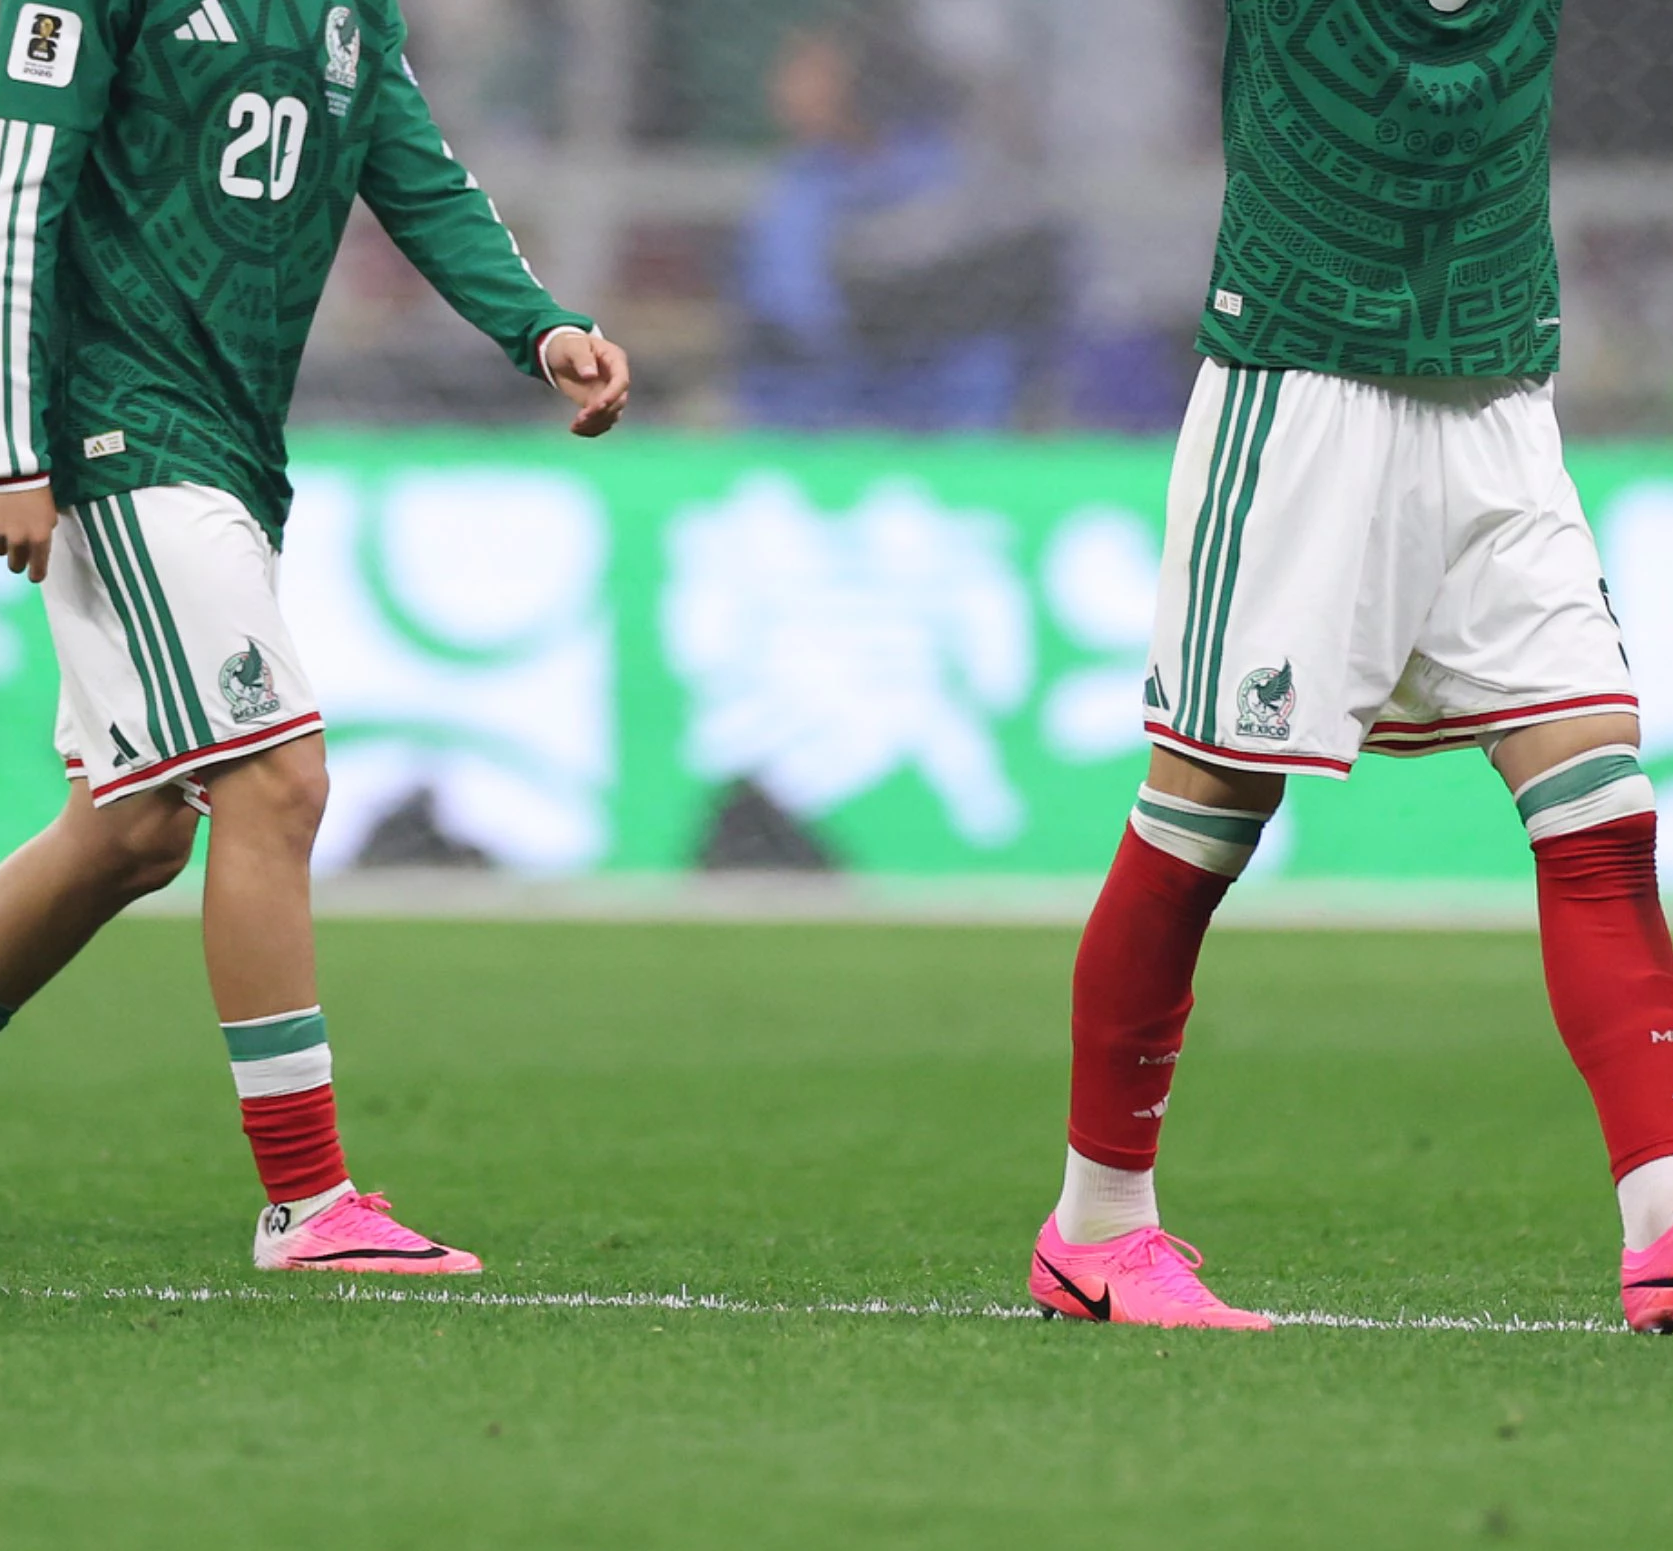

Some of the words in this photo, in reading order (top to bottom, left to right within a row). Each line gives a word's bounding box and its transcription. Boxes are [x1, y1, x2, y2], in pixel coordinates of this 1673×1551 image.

[219, 91, 308, 201] 20
[233, 699, 279, 720] MEXICO
[1238, 721, 1287, 736] MEXICO
